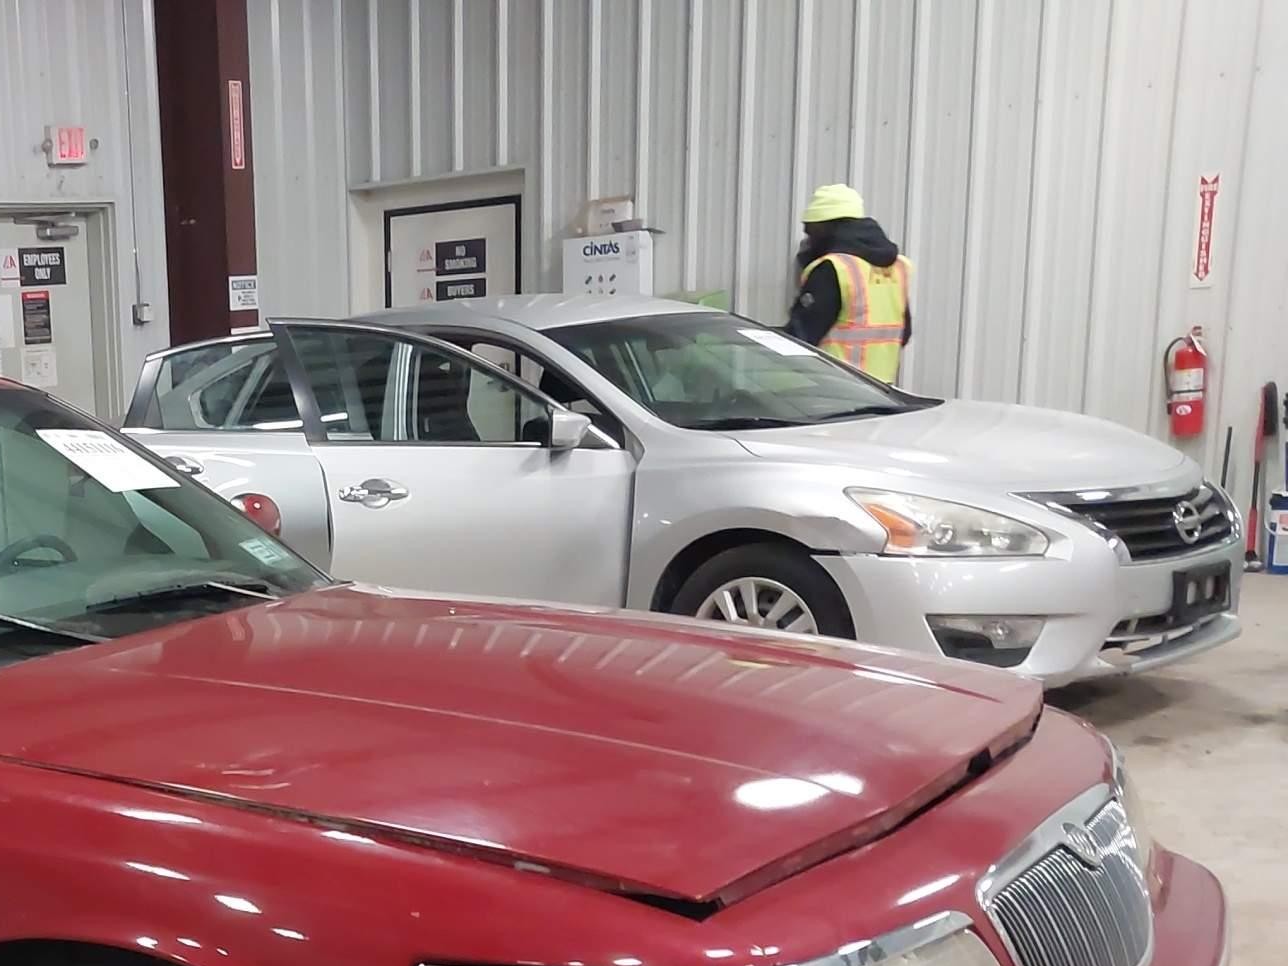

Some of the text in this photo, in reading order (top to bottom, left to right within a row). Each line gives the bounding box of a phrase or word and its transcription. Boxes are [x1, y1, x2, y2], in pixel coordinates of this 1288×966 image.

[1198, 192, 1211, 278] EXTINGUISHER
[23, 253, 61, 266] EMPLOYEES
[34, 267, 51, 280] ONLY
